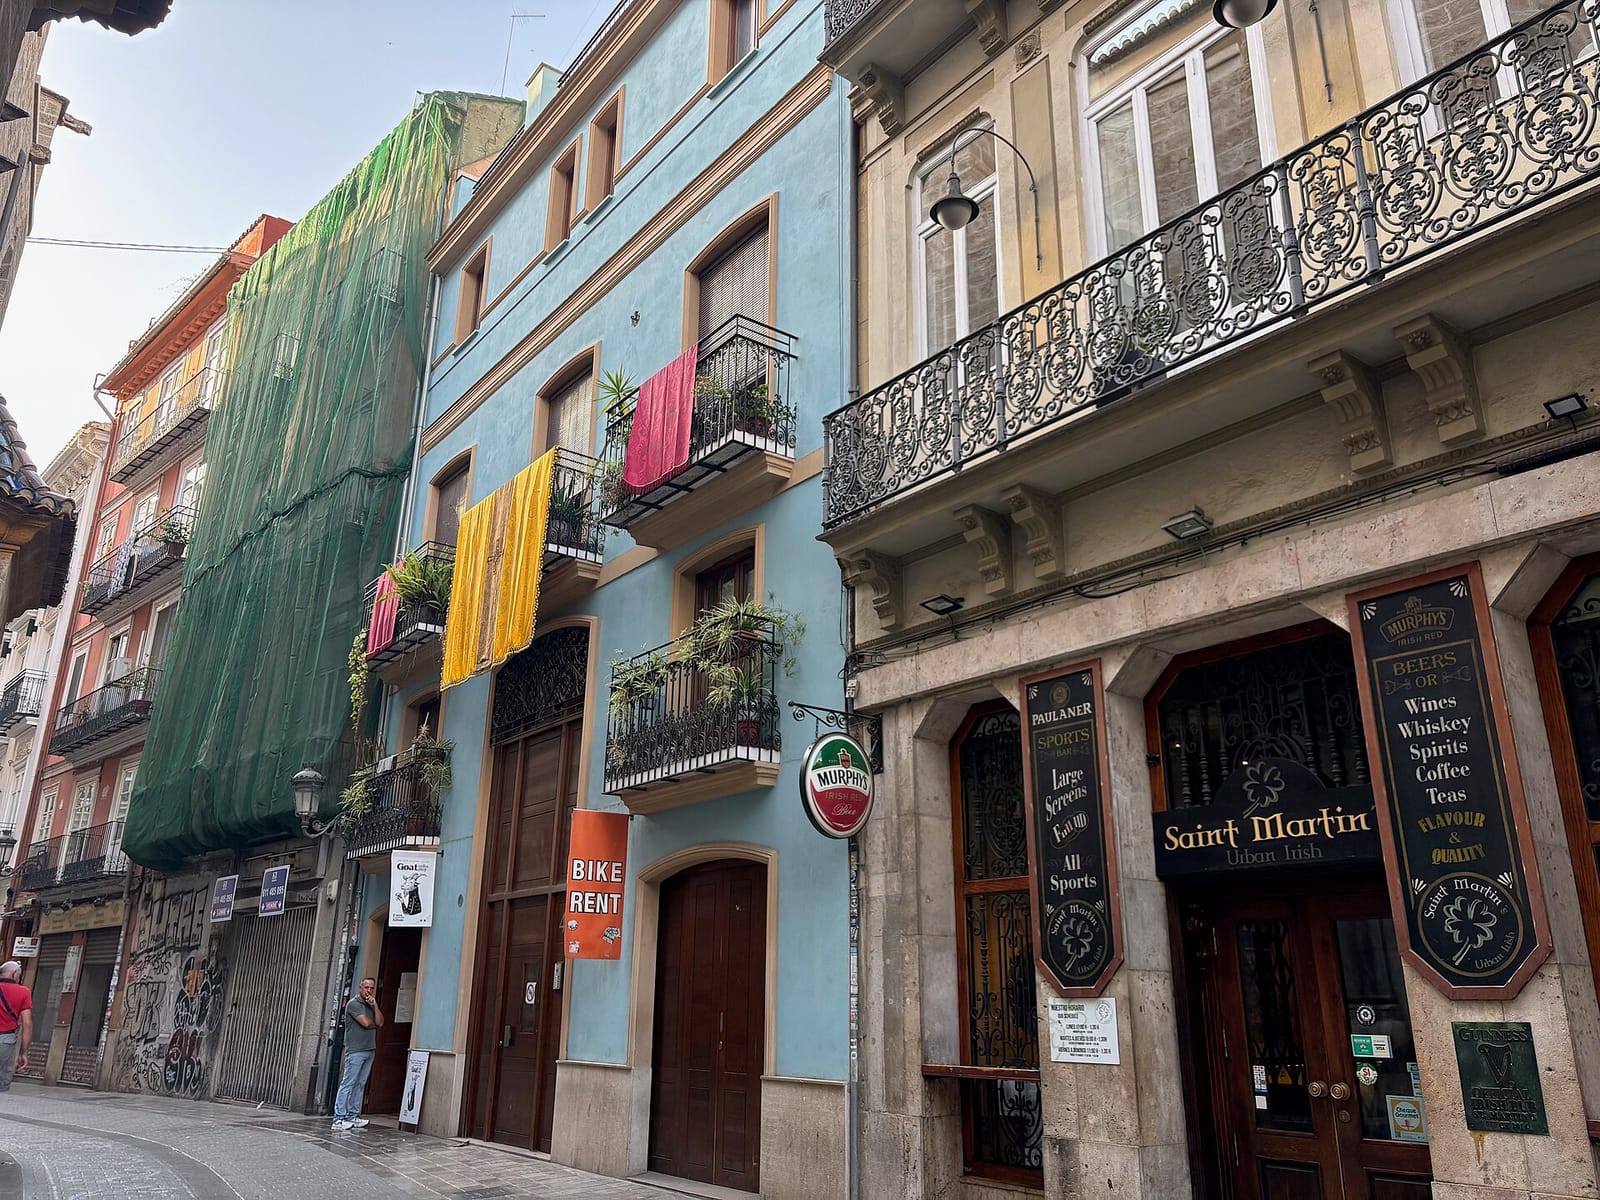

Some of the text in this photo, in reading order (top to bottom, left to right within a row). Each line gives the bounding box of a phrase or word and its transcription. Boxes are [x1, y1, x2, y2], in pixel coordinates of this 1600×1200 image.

[1398, 631, 1443, 647] IRISH RED
[1393, 651, 1457, 676] BEERS
[1415, 674, 1438, 688] OR
[1032, 702, 1093, 726] PAULANER
[1404, 696, 1457, 715] Wines
[1397, 716, 1471, 739] Whiskey
[1038, 728, 1090, 750] SPORTS
[1410, 739, 1468, 763] Spirits
[1052, 768, 1084, 791] Large
[1415, 762, 1472, 783] Coffee
[825, 791, 849, 801] IRISH
[1045, 785, 1088, 822] Screens
[1426, 787, 1467, 805] Teas
[1052, 812, 1087, 844] Full HD
[1417, 811, 1487, 833] FLAVOUR
[1164, 819, 1240, 851] Saint
[1449, 832, 1461, 844] &
[1063, 854, 1081, 872] All
[1226, 842, 1324, 866] Urban Irish
[1431, 844, 1487, 865] QUALITY
[396, 862, 418, 871] Goat
[571, 858, 624, 884] BIKE
[1050, 873, 1097, 895] Sports
[568, 891, 622, 914] RENT
[1424, 885, 1449, 919] Saint
[1050, 911, 1067, 936] Saint
[1475, 931, 1516, 969] Urban Irish
[1459, 1027, 1529, 1042] GUINNESS
